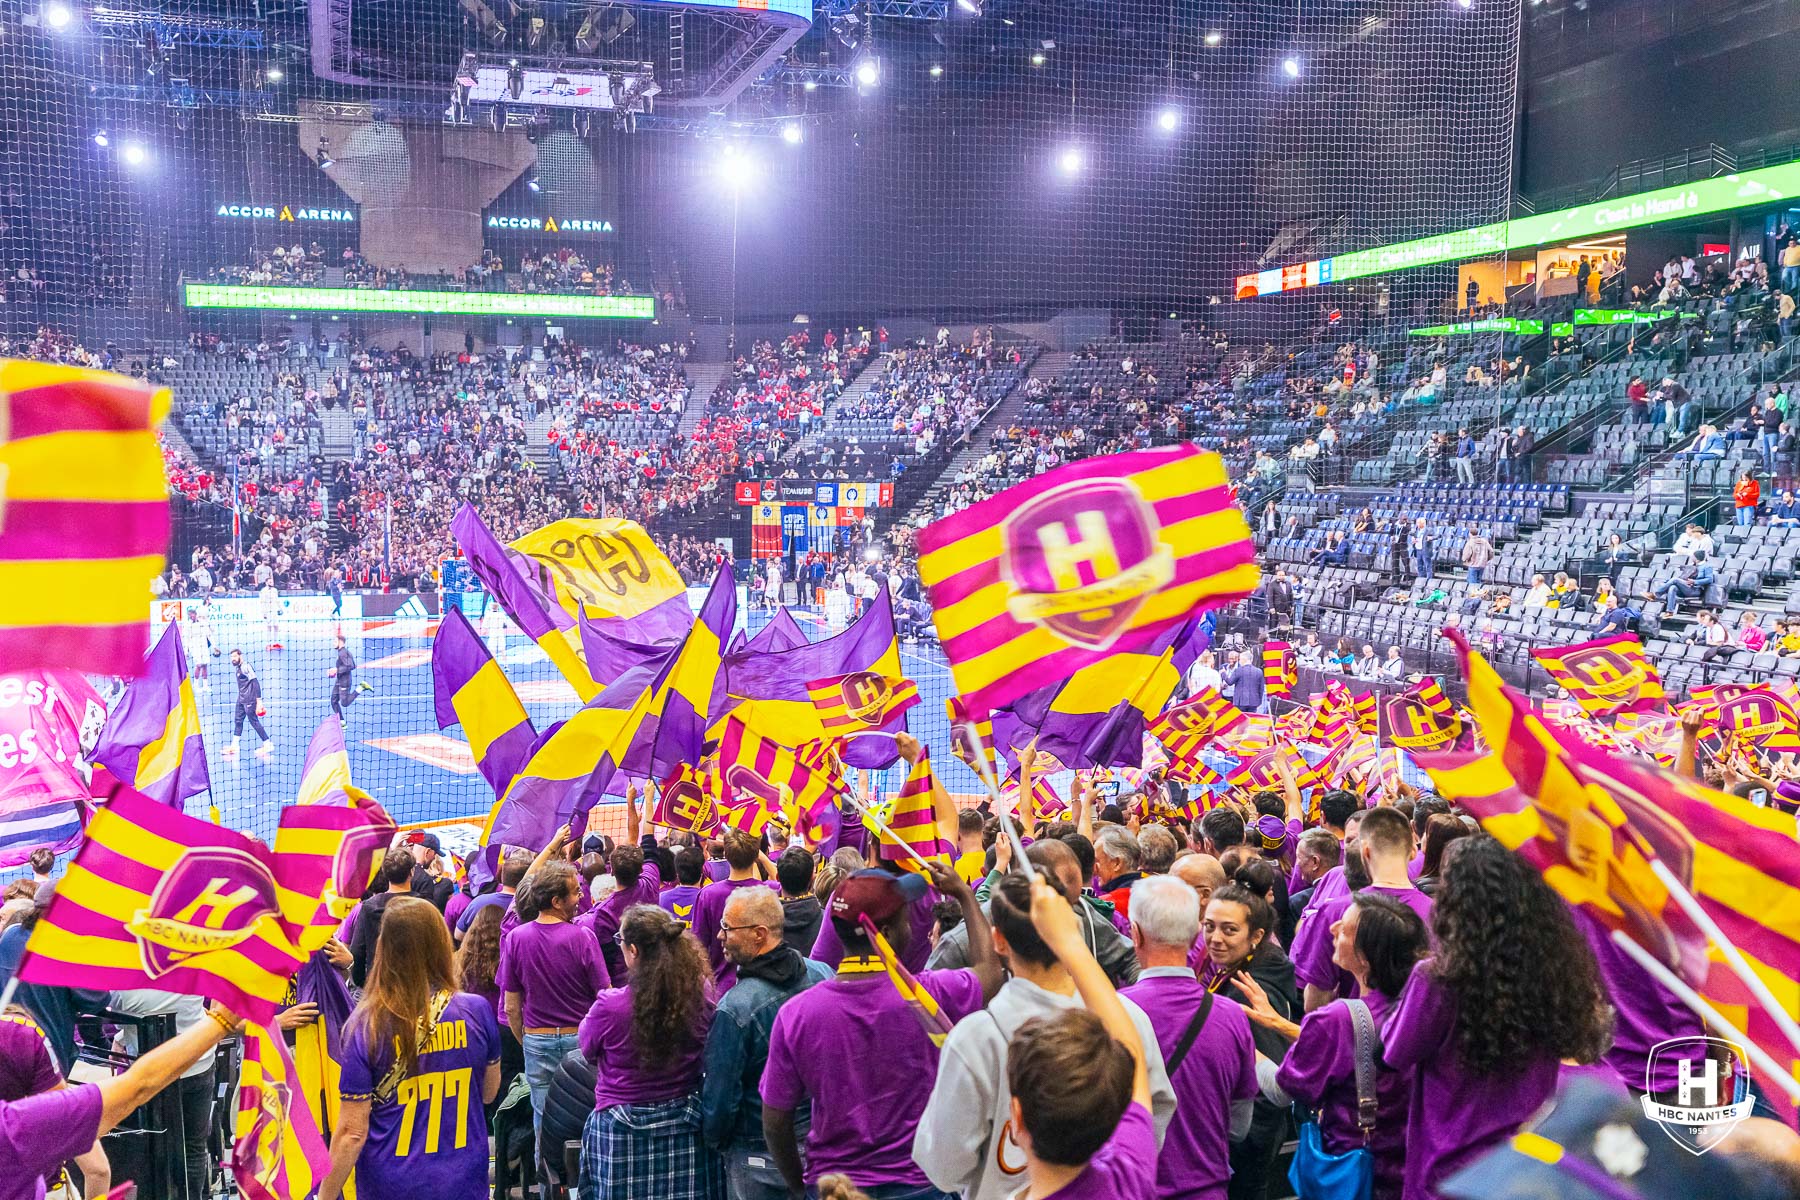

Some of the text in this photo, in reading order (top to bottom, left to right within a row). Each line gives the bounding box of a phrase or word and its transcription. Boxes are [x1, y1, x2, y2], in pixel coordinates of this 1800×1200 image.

[218, 205, 353, 221] ACCOR ARENA
[489, 216, 613, 232] ACCOR ARENA
[1036, 510, 1122, 591] H
[854, 676, 881, 707] H
[1406, 705, 1441, 737] H
[1732, 702, 1762, 731] H
[673, 793, 702, 821] H
[173, 877, 259, 929] H
[395, 1067, 473, 1157] 777
